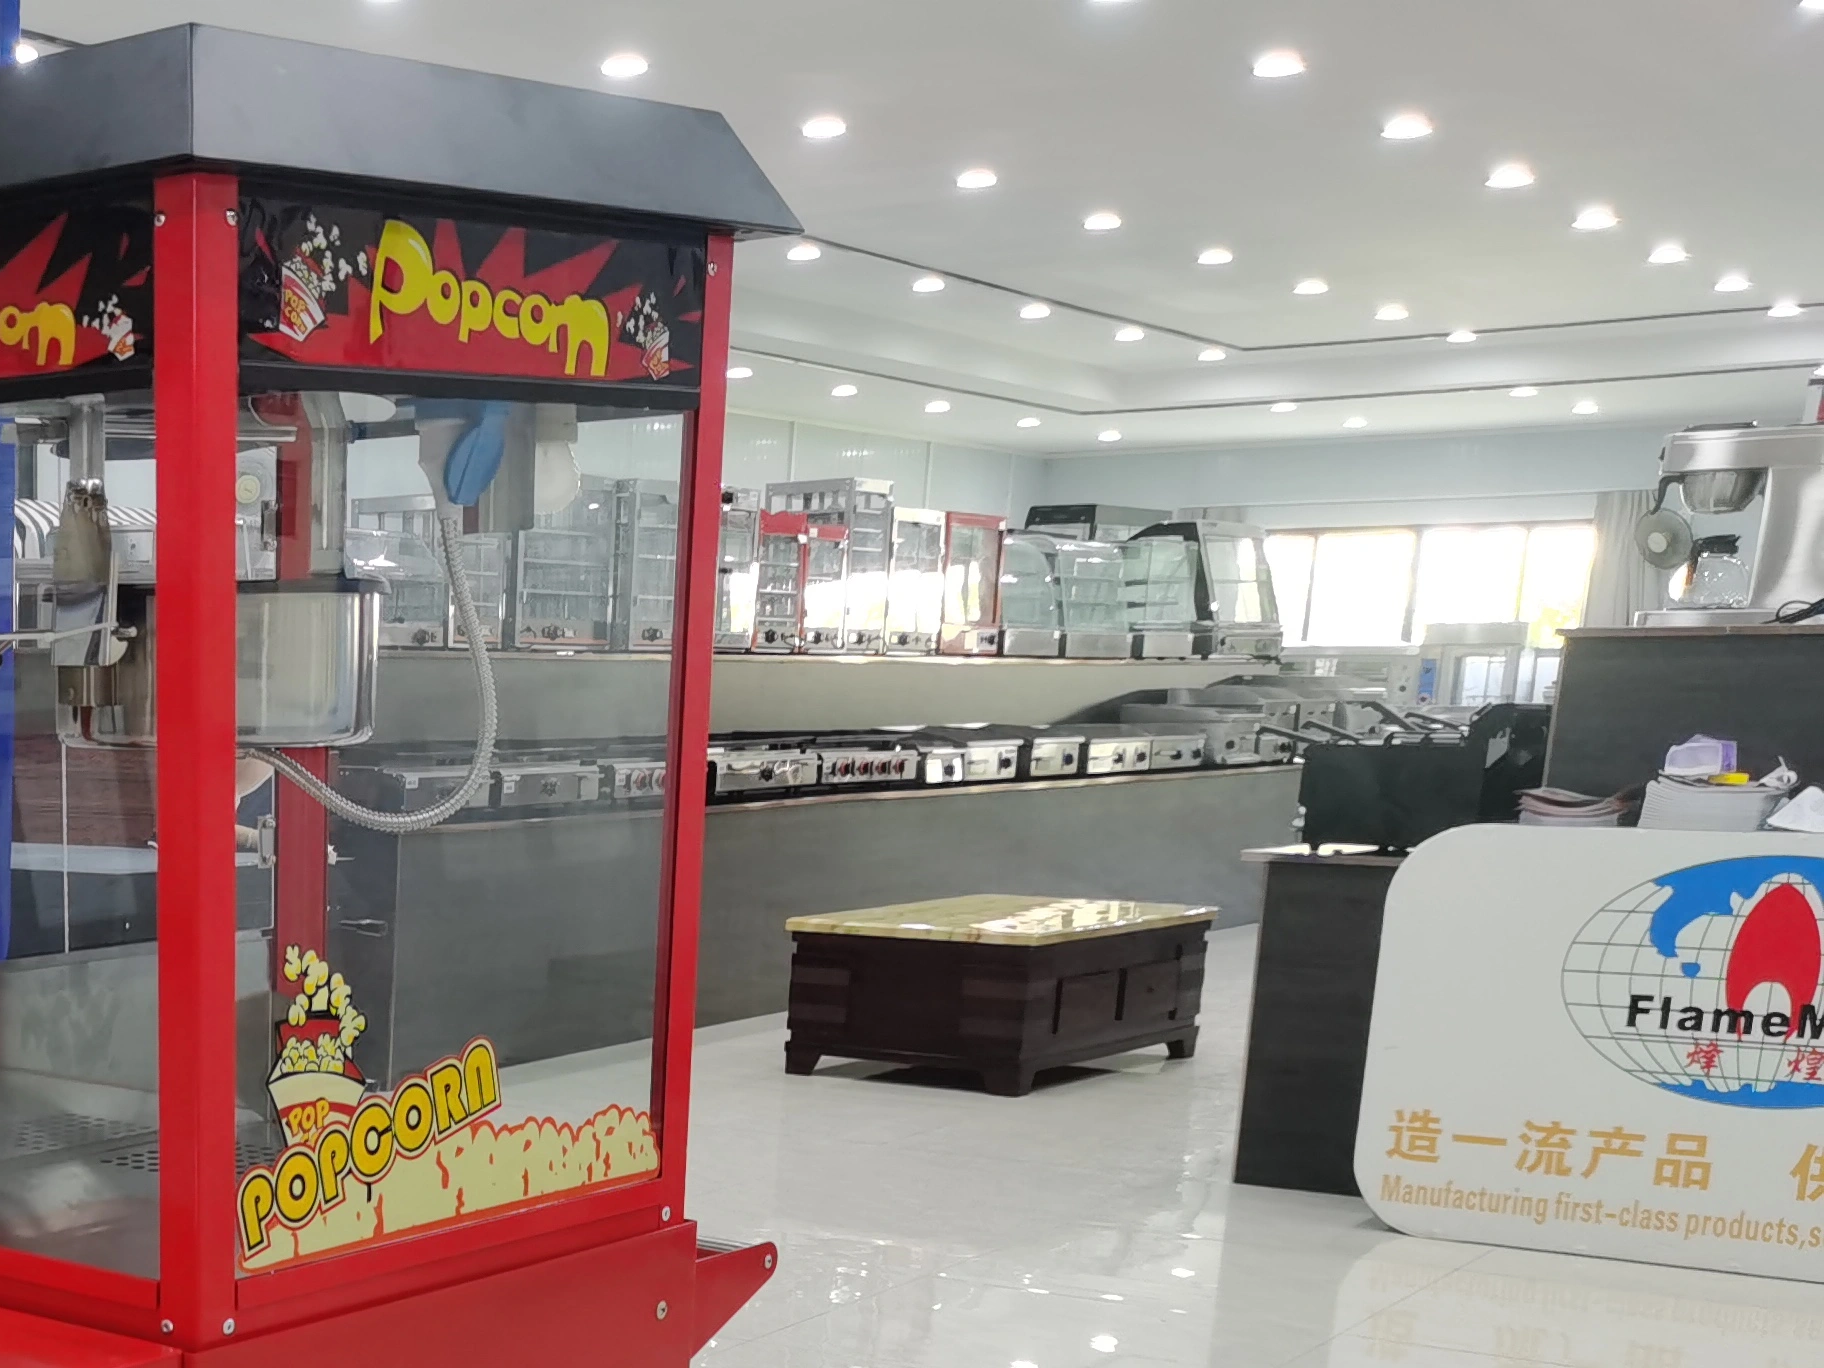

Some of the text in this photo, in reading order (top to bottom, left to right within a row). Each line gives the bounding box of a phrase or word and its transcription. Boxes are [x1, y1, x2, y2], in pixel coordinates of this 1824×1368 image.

[238, 1041, 499, 1254] POPCORN
[285, 1097, 331, 1137] POP
[1384, 1108, 1713, 1192] 造一流产品
[1379, 1173, 1549, 1225] Manufacturing
[1553, 1188, 1679, 1233] first-class
